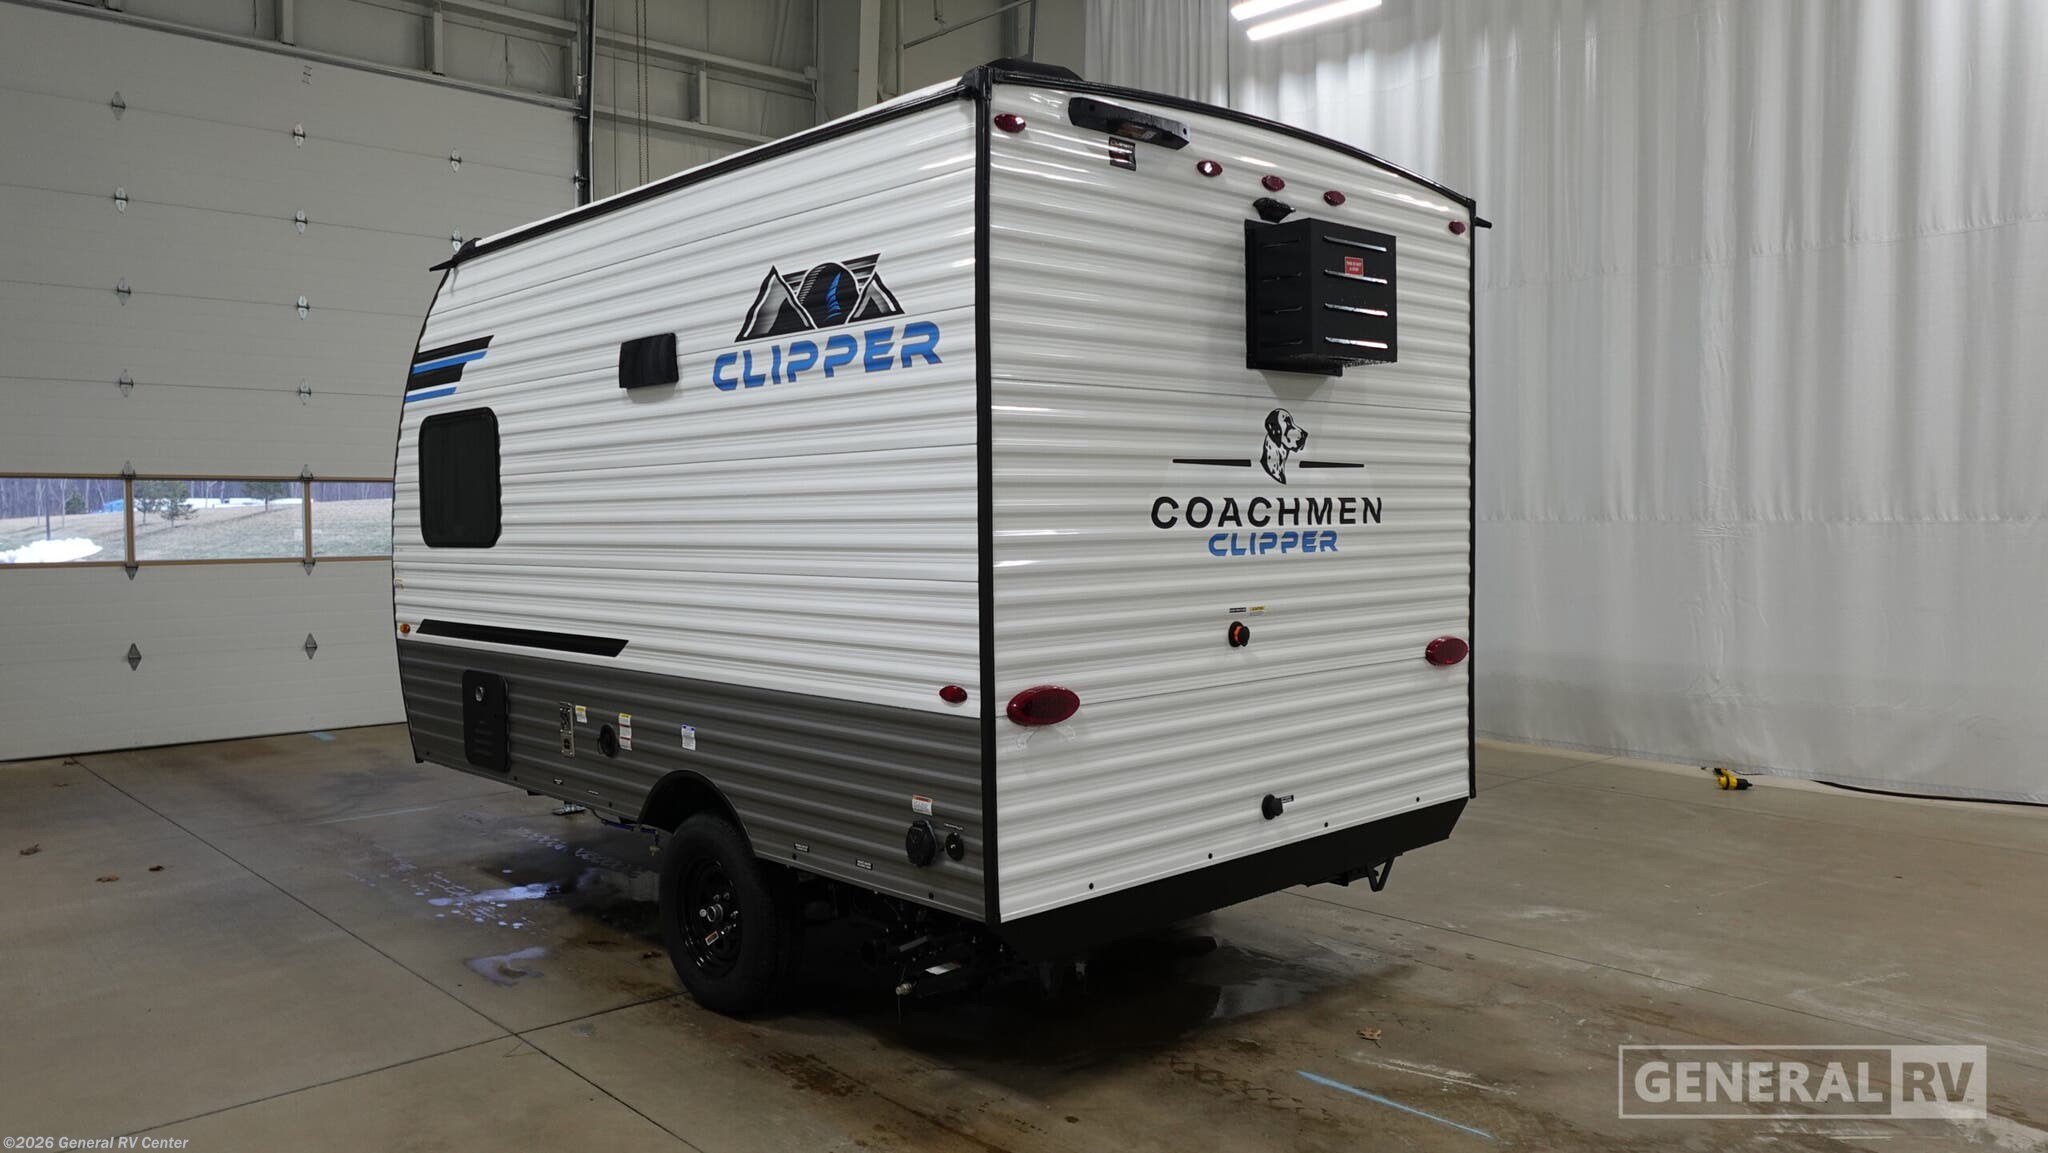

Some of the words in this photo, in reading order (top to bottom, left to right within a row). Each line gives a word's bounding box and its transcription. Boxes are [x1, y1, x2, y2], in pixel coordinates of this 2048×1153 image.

[712, 320, 943, 391] CLIPPER
[1151, 496, 1383, 529] COACHMEN
[1208, 530, 1338, 557] CLIPPER
